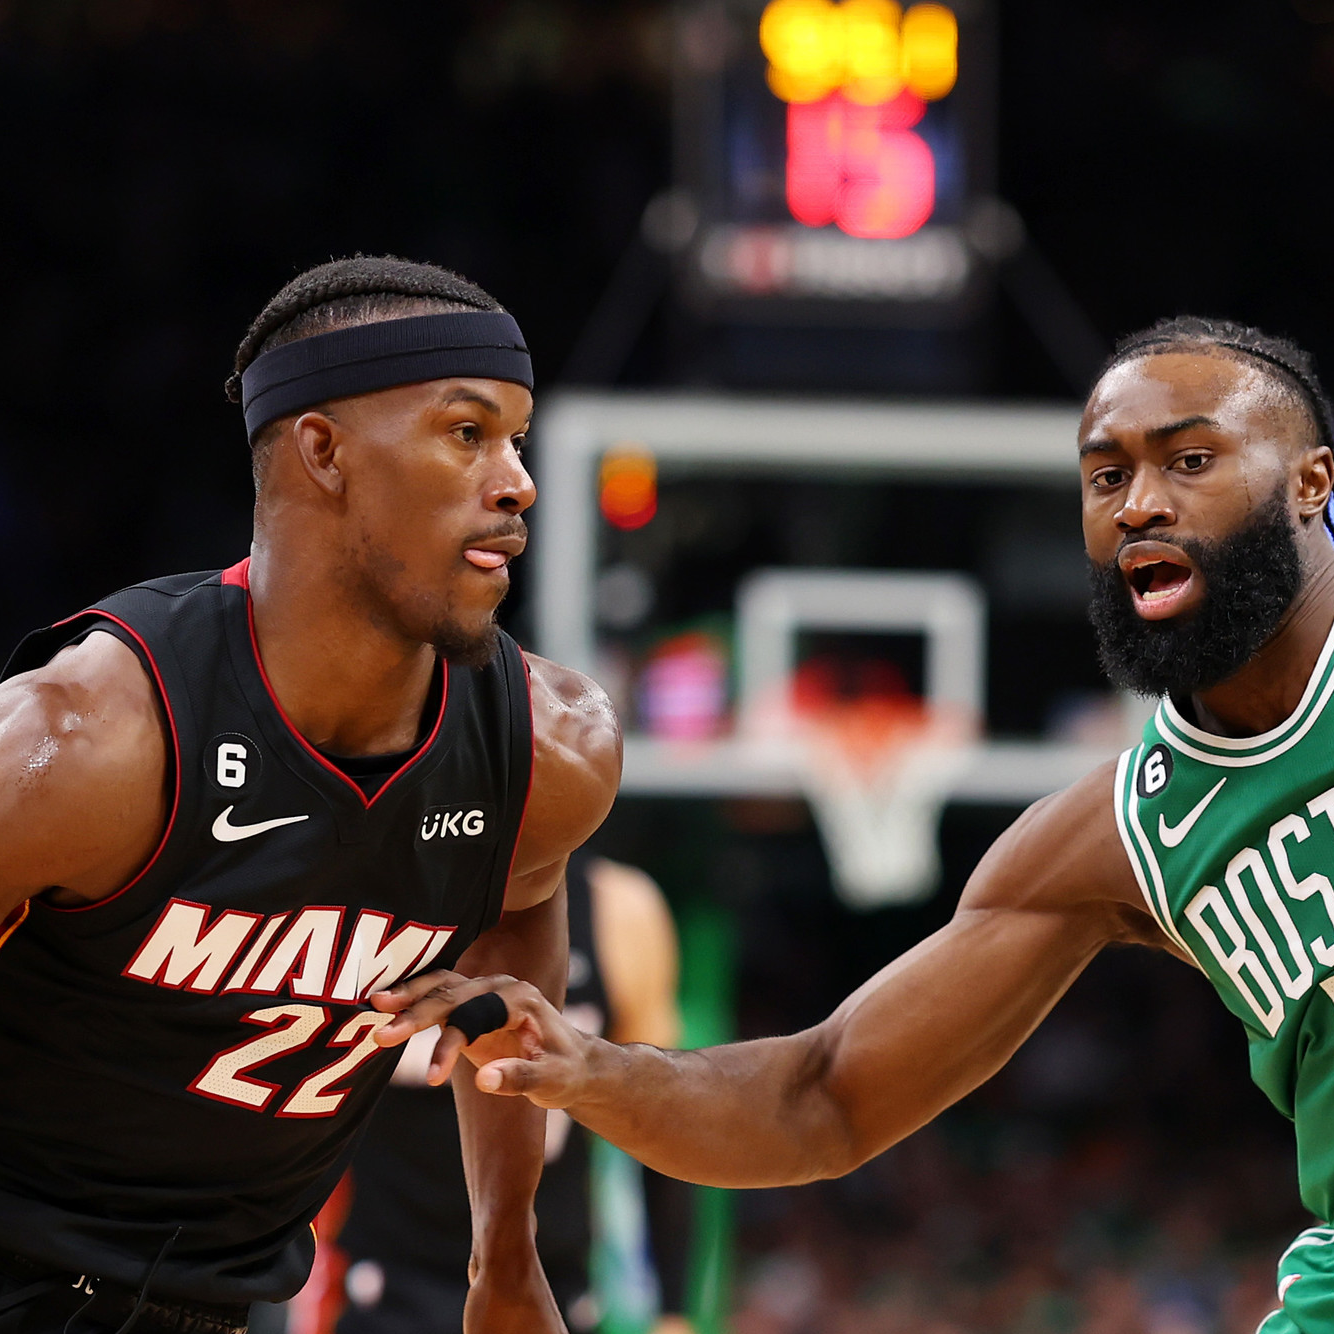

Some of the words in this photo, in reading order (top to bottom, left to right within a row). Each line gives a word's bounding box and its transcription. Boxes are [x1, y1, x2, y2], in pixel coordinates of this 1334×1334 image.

[217, 742, 248, 788] 6
[1144, 750, 1167, 794] 6
[185, 1002, 400, 1118] 22
